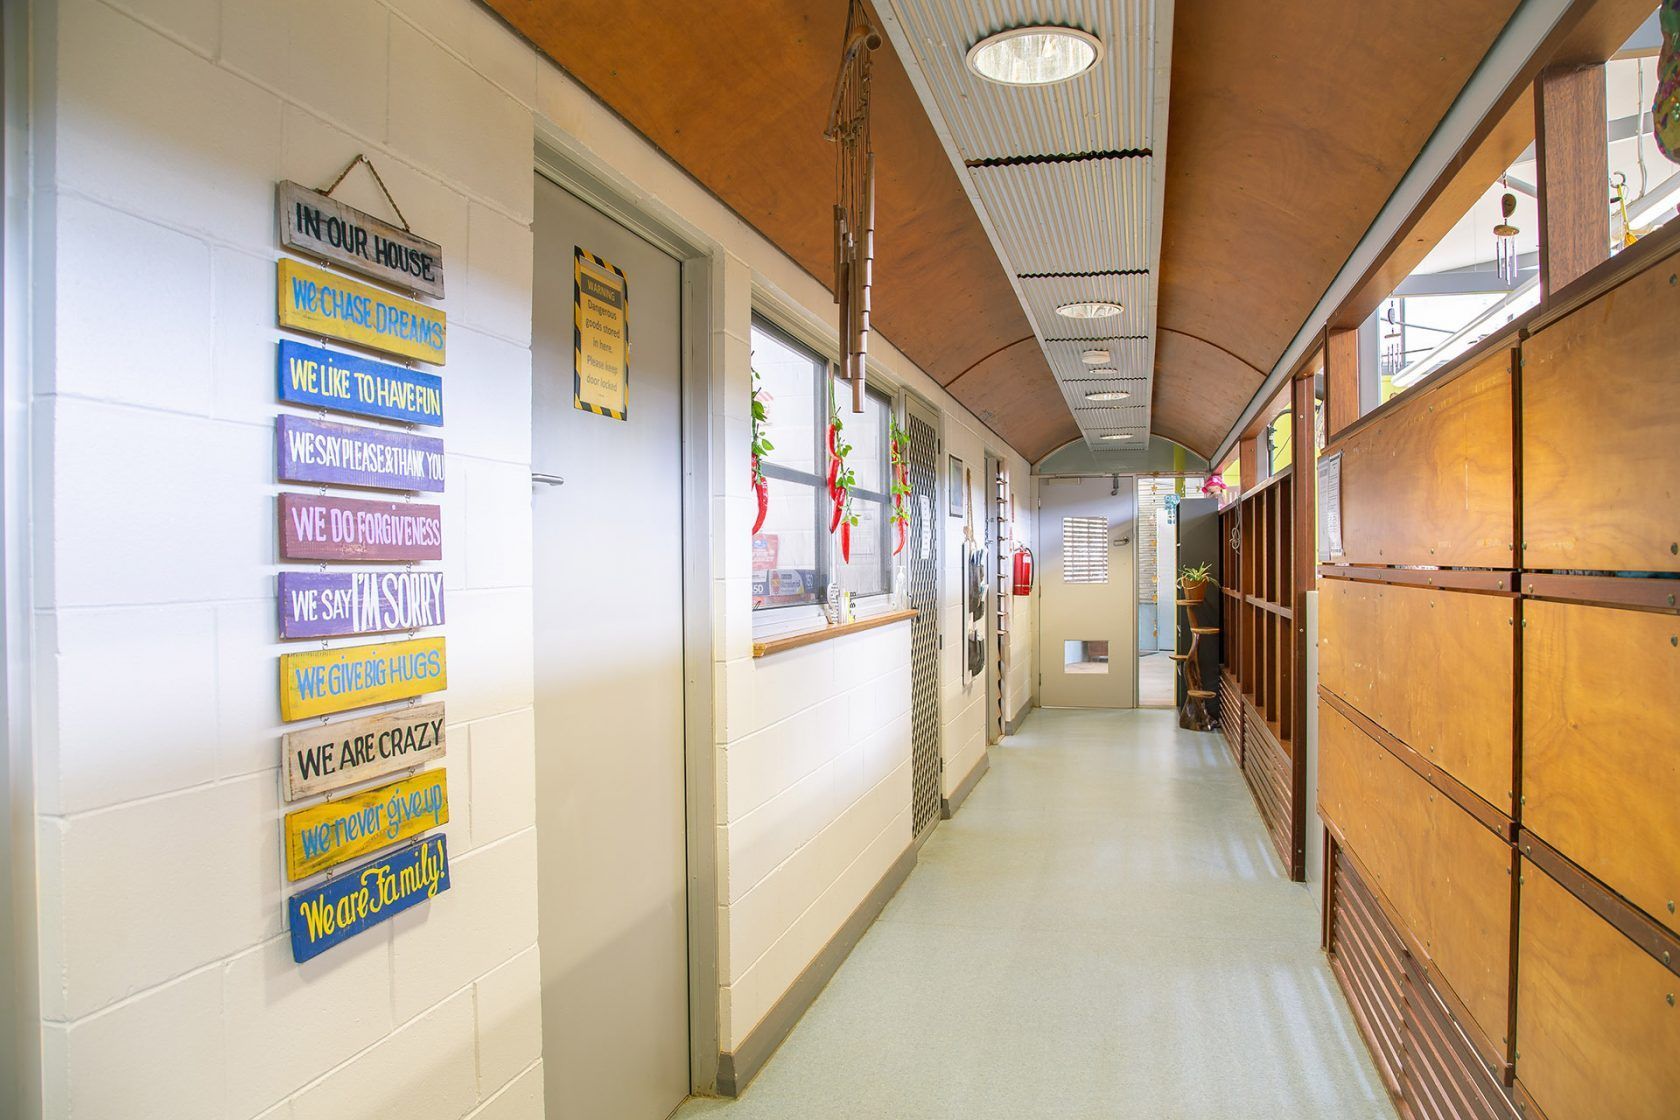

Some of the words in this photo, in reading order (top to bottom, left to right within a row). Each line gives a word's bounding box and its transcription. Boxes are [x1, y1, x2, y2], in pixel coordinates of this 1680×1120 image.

[296, 202, 321, 241] IN
[327, 217, 368, 260] OUR
[374, 235, 435, 282] HOUSE
[320, 286, 373, 328] CHASE
[587, 279, 617, 302] WARNING
[588, 299, 617, 321] Dangerous
[586, 318, 602, 331] goods
[602, 324, 620, 339] stored
[587, 355, 604, 370] Please
[587, 374, 600, 386] door
[600, 378, 617, 392] locked
[289, 357, 318, 393] WE
[354, 372, 374, 404] TO
[377, 377, 415, 412] HAVE
[415, 385, 441, 416] FUN
[288, 430, 315, 464] WE
[314, 434, 342, 467] SAY
[392, 447, 425, 479] THANK
[426, 451, 445, 481] YOU
[292, 506, 327, 542] WE
[330, 508, 354, 543] DO
[292, 589, 317, 622] WE
[321, 588, 352, 621] SAY
[352, 573, 382, 632] I'M
[381, 573, 443, 628] SORRY
[753, 583, 764, 594] 50
[295, 666, 326, 701] WE
[390, 650, 441, 683] HUGS
[298, 743, 336, 780] WE
[339, 733, 375, 770] ARE
[378, 718, 444, 759] CRAZY
[301, 822, 331, 860] we
[335, 803, 384, 847] never
[386, 789, 422, 839] give
[423, 784, 443, 825] up
[300, 894, 335, 943] We
[336, 887, 369, 929] are
[360, 839, 445, 913] Family!
